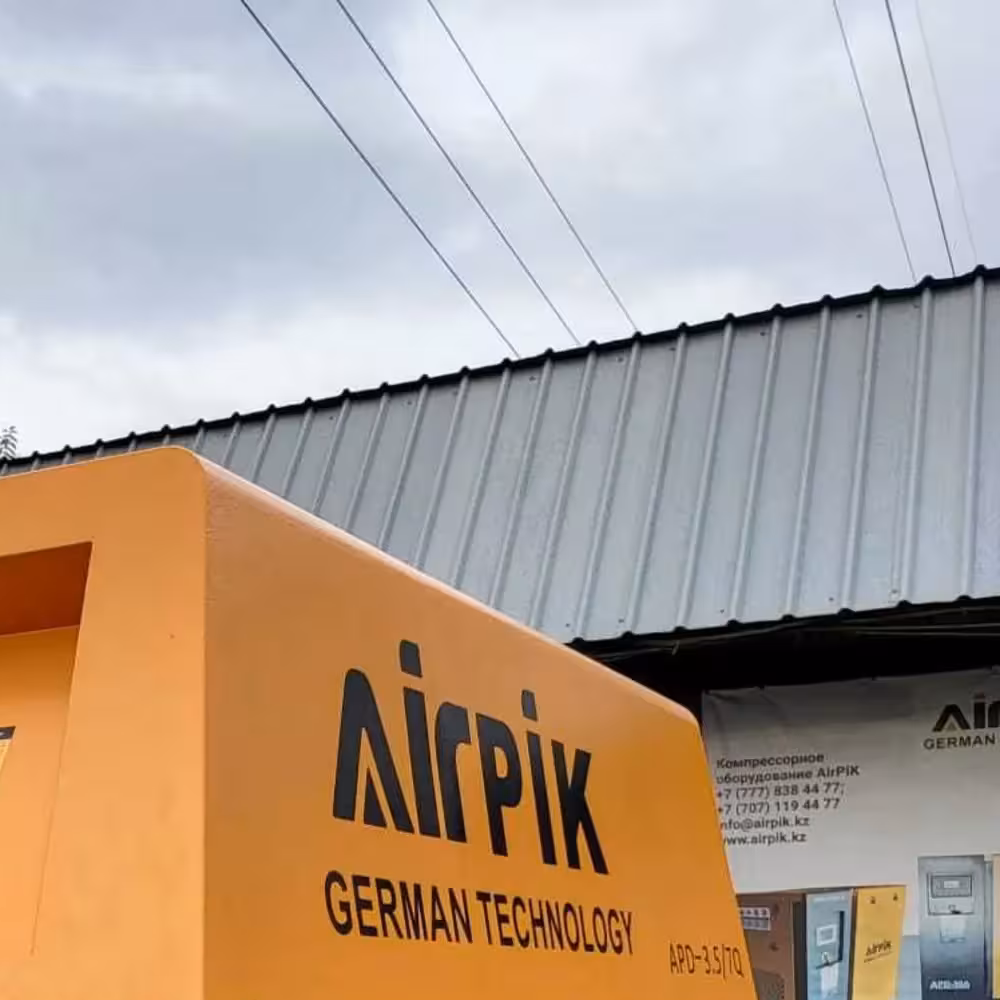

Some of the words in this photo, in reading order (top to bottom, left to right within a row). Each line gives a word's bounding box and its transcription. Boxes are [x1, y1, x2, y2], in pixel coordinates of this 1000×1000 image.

[923, 732, 995, 750] GERMAN
[716, 753, 824, 769] Компрессорное
[716, 769, 813, 784] оборудование
[736, 786, 770, 799] (777)
[774, 784, 799, 796] 838
[803, 784, 819, 794] 44
[736, 801, 770, 815] (707)
[775, 800, 799, 811] 119
[803, 799, 819, 810] 44
[823, 797, 840, 809] 77
[720, 816, 809, 831] nfo@airpik.kz
[324, 870, 473, 944] GERMAN
[475, 890, 634, 955] TECHNOLOGY
